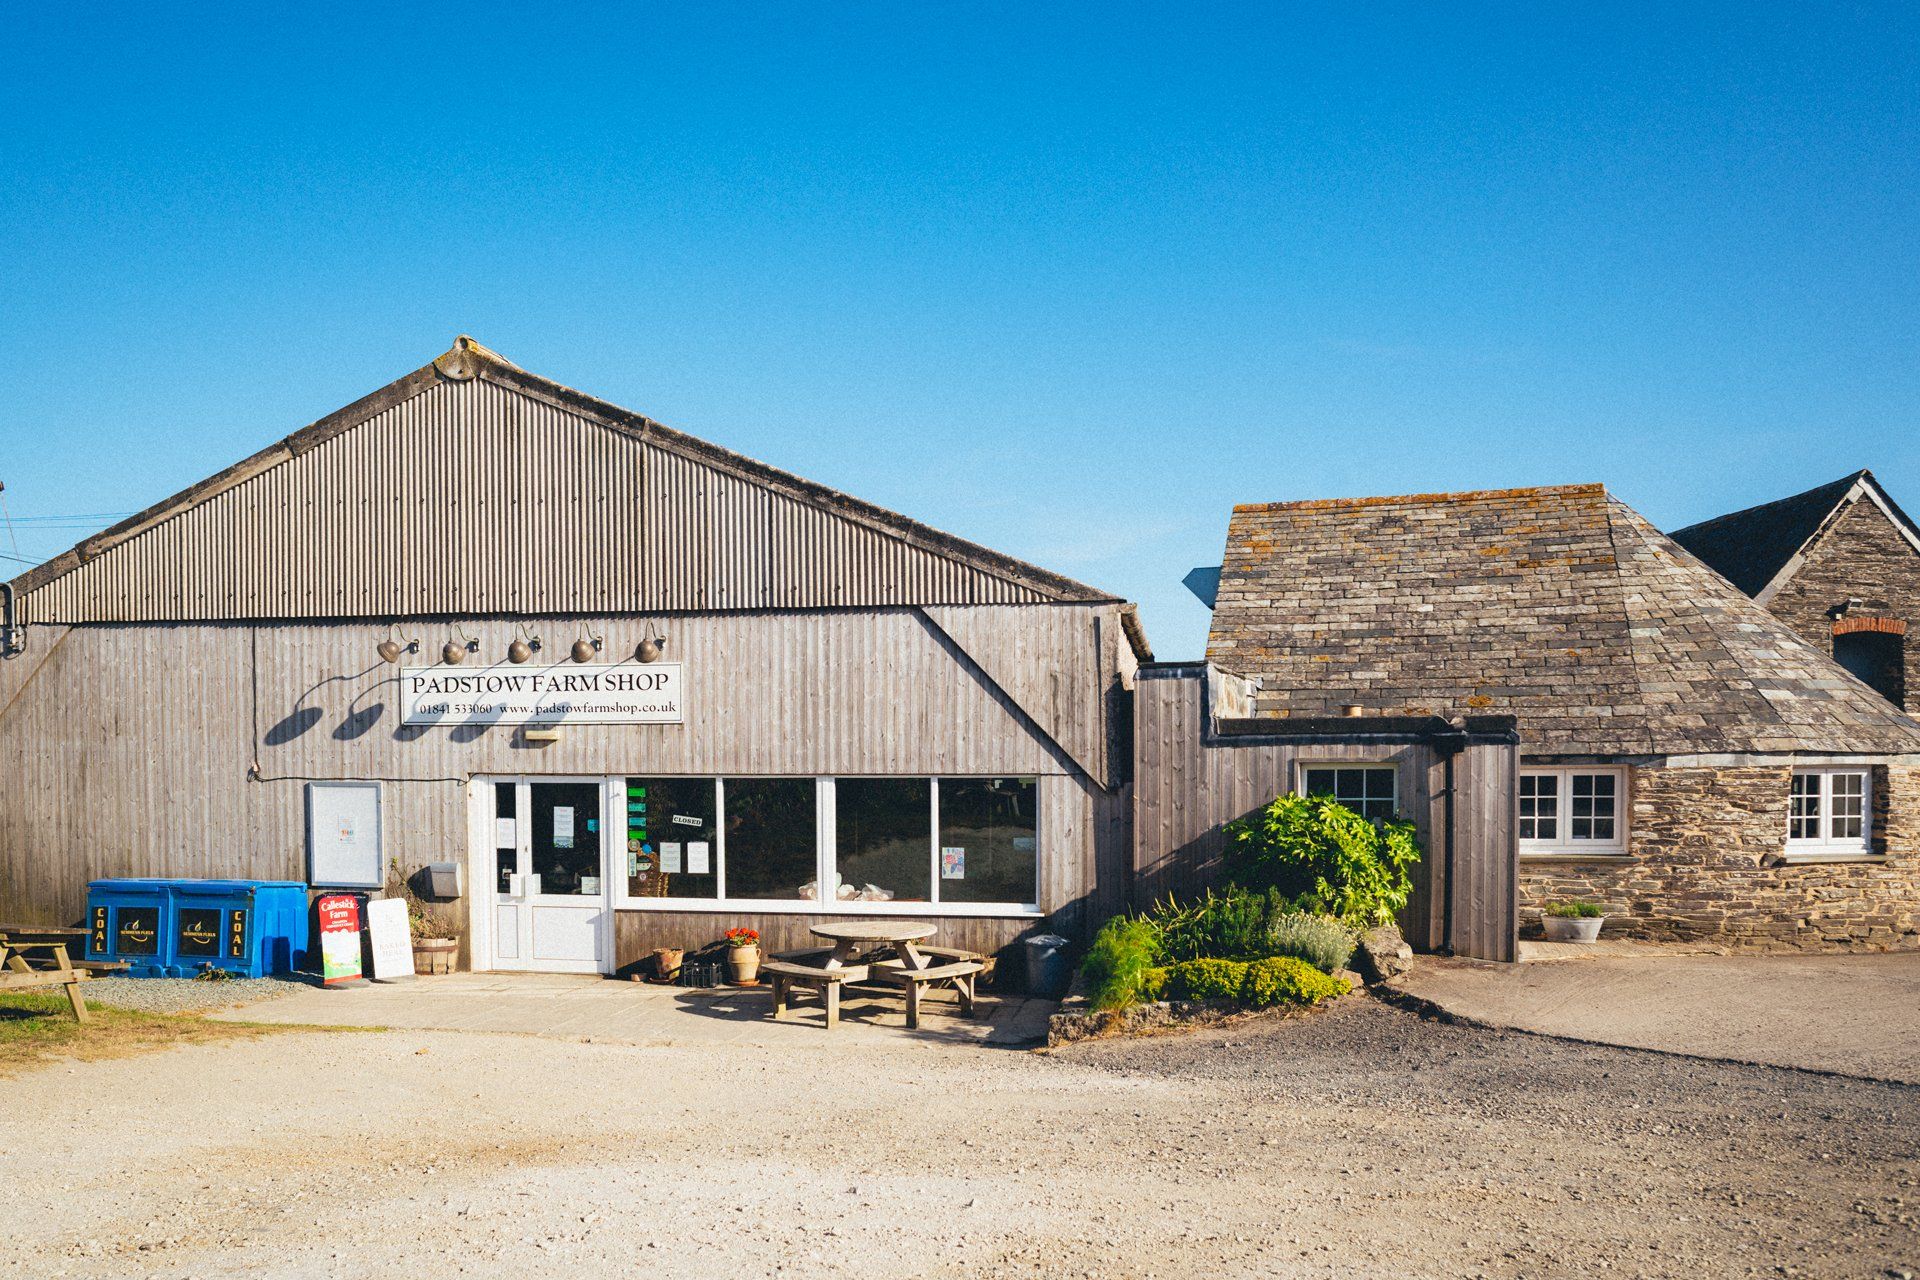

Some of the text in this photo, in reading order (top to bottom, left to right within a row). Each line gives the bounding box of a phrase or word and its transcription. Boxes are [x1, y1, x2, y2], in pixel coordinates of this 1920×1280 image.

[412, 673, 669, 694] PADSTOW FARM SHOP
[419, 700, 677, 716] 01841 533060 www.padstowfarmshop.co.uk
[674, 816, 701, 826] CLOSED
[321, 899, 355, 911] Callestick
[329, 910, 348, 919] Farm
[96, 908, 105, 951] COAL
[233, 911, 242, 956] COAL
